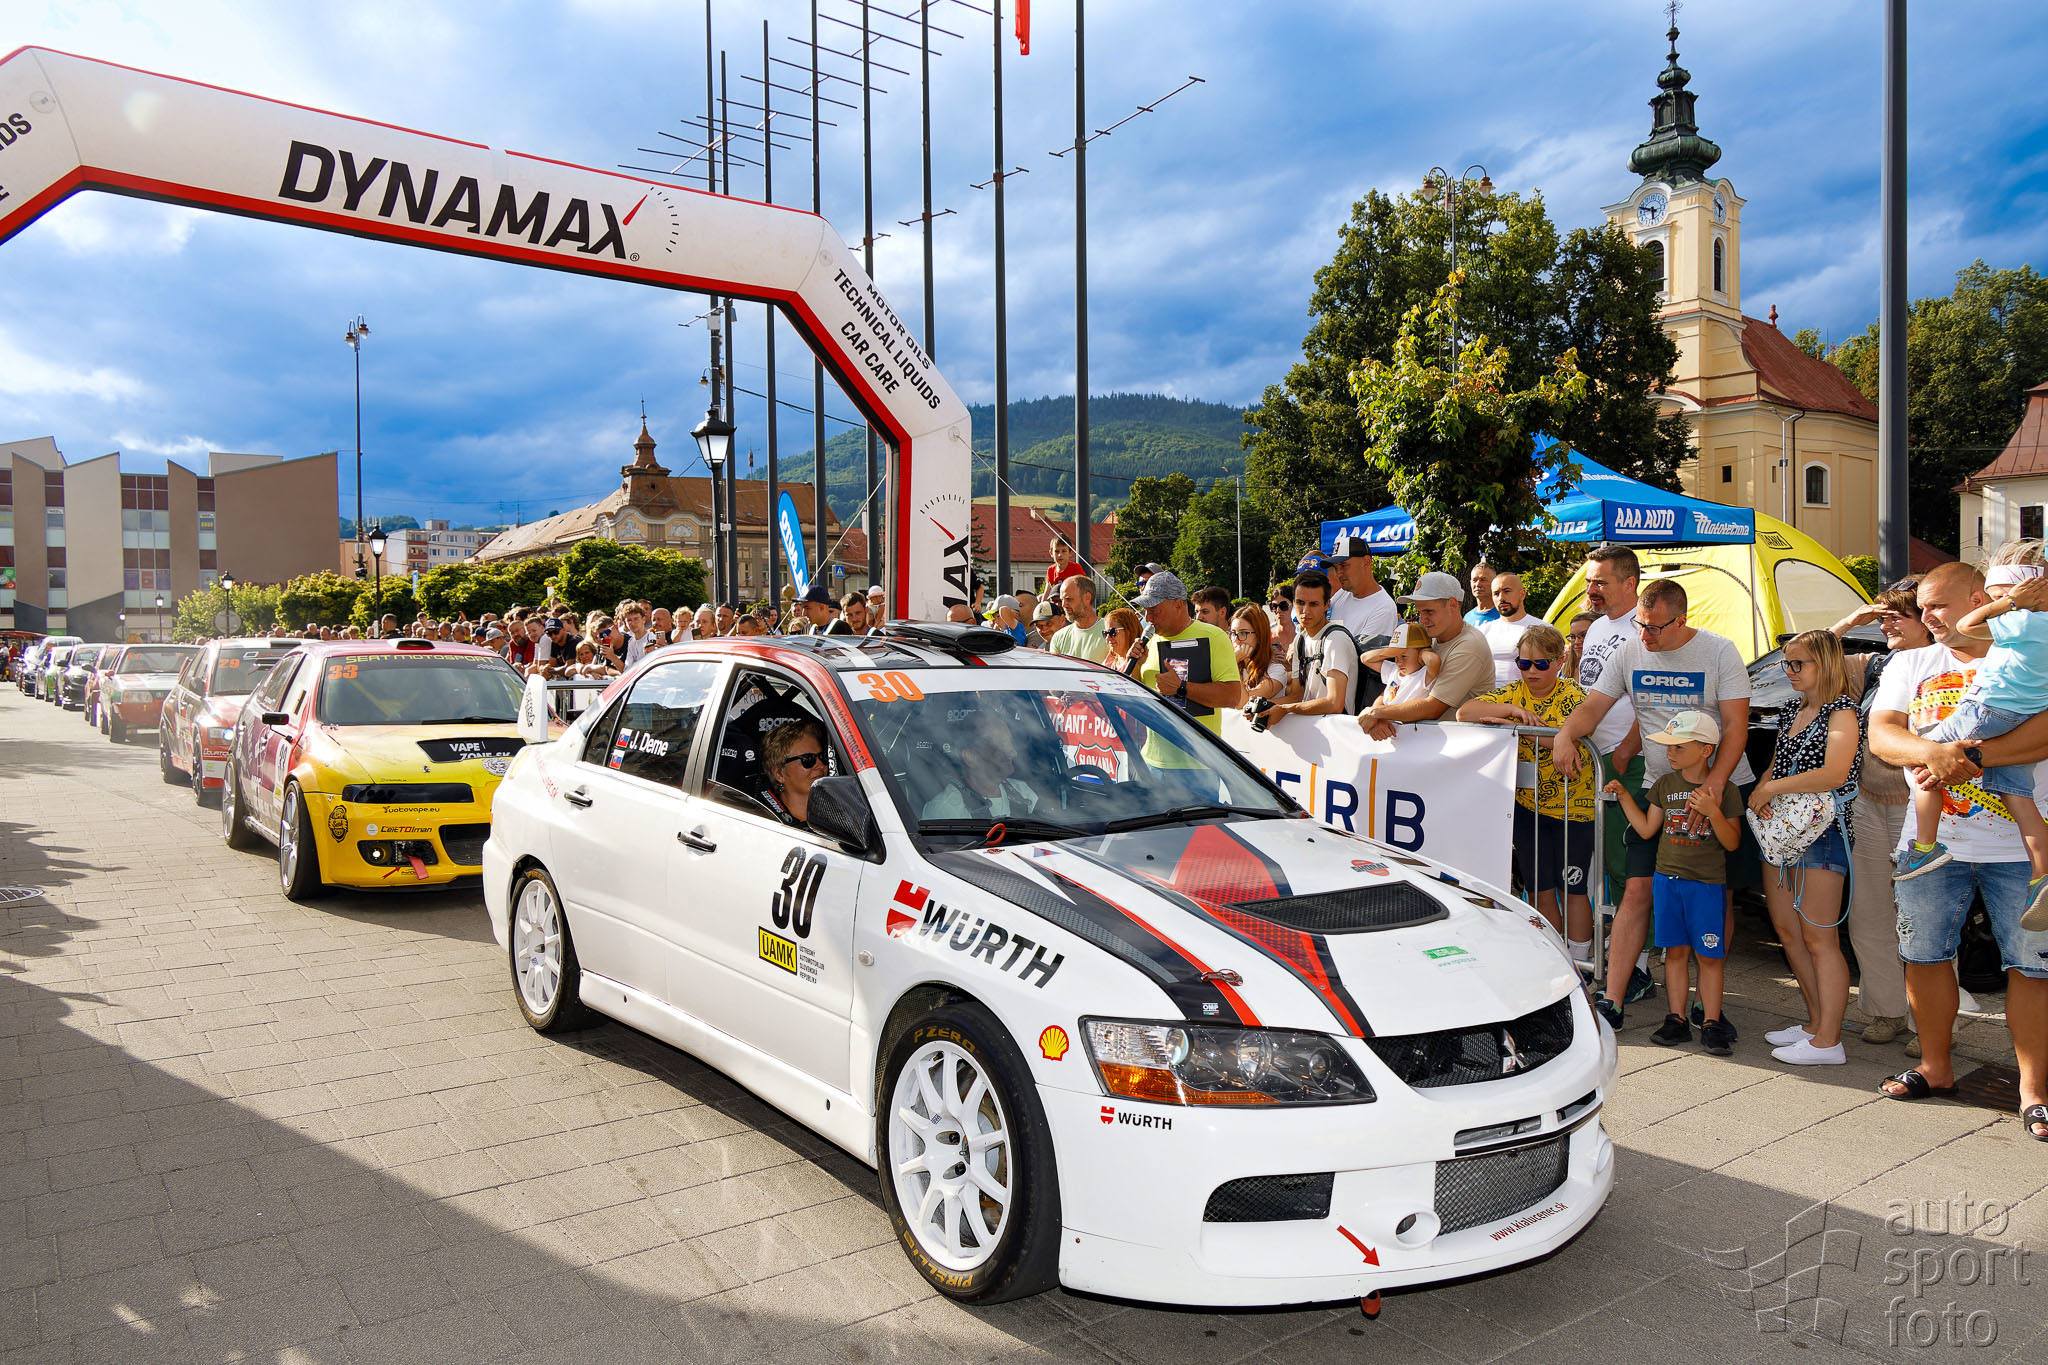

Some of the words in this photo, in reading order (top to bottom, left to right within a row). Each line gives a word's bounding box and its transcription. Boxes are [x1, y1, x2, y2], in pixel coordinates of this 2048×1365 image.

[278, 140, 632, 260] DYNAMAX
[866, 283, 905, 336] MOTOR
[906, 336, 931, 370] OILS
[834, 268, 895, 354] TECHNICAL
[893, 350, 941, 410] LIQUIDS
[841, 321, 870, 355] CAR
[865, 352, 900, 394] CARE
[1615, 507, 1643, 528] AAA
[1644, 508, 1675, 529] AUTO
[327, 664, 359, 681] 33
[1640, 674, 1695, 688] ORIG.
[857, 671, 926, 703] 30
[1636, 692, 1699, 705] DENIM
[449, 743, 481, 752] VAPE
[630, 730, 641, 750] J.
[772, 846, 828, 939] 30
[1118, 1112, 1173, 1130] WÜRTH
